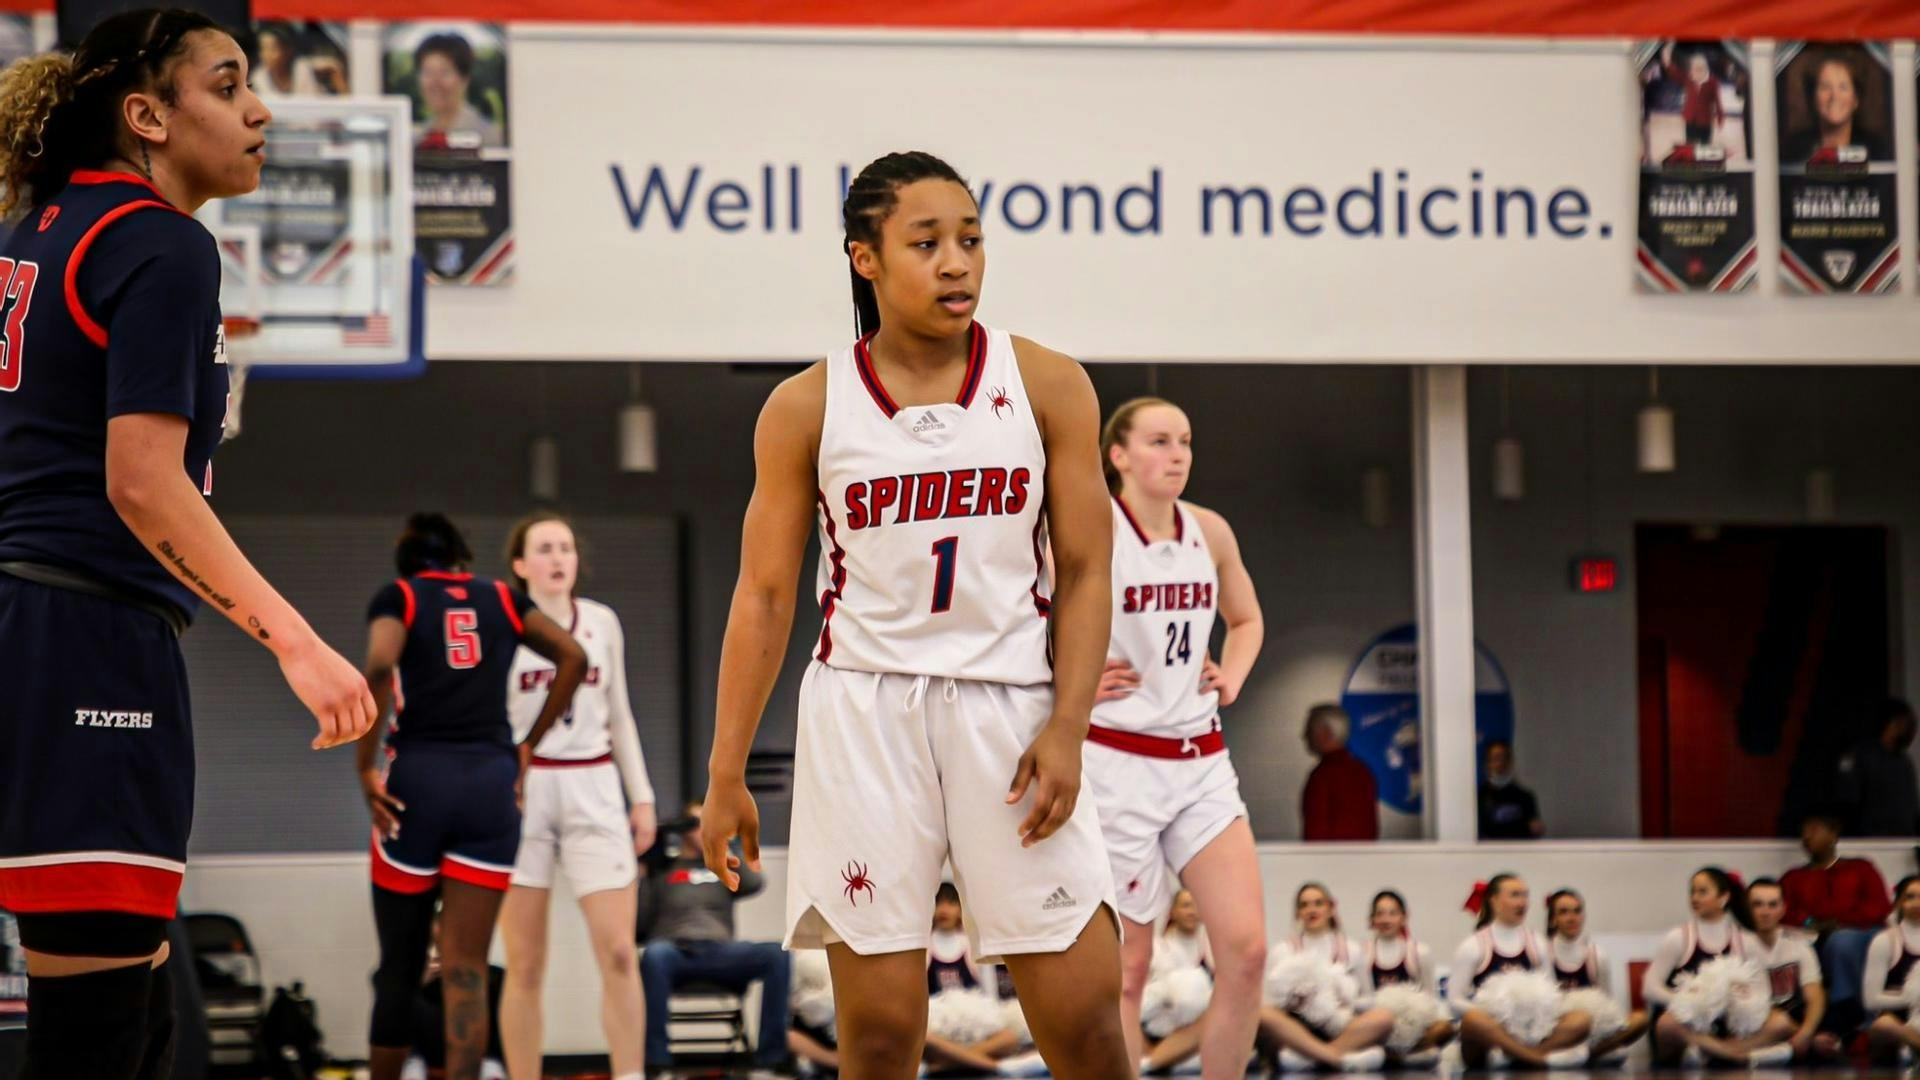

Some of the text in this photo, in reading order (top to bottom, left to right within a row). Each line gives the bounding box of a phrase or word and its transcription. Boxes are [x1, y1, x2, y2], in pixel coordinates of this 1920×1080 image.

[609, 164, 802, 232] Well
[1201, 168, 1614, 239] medicine.
[913, 423, 946, 433] adidas
[845, 467, 1031, 531] SPIDERS
[930, 536, 960, 614] 1
[1123, 582, 1212, 613] SPIDERS
[444, 608, 482, 669] 5
[1165, 621, 1192, 667] 24
[75, 709, 153, 728] FLYERS
